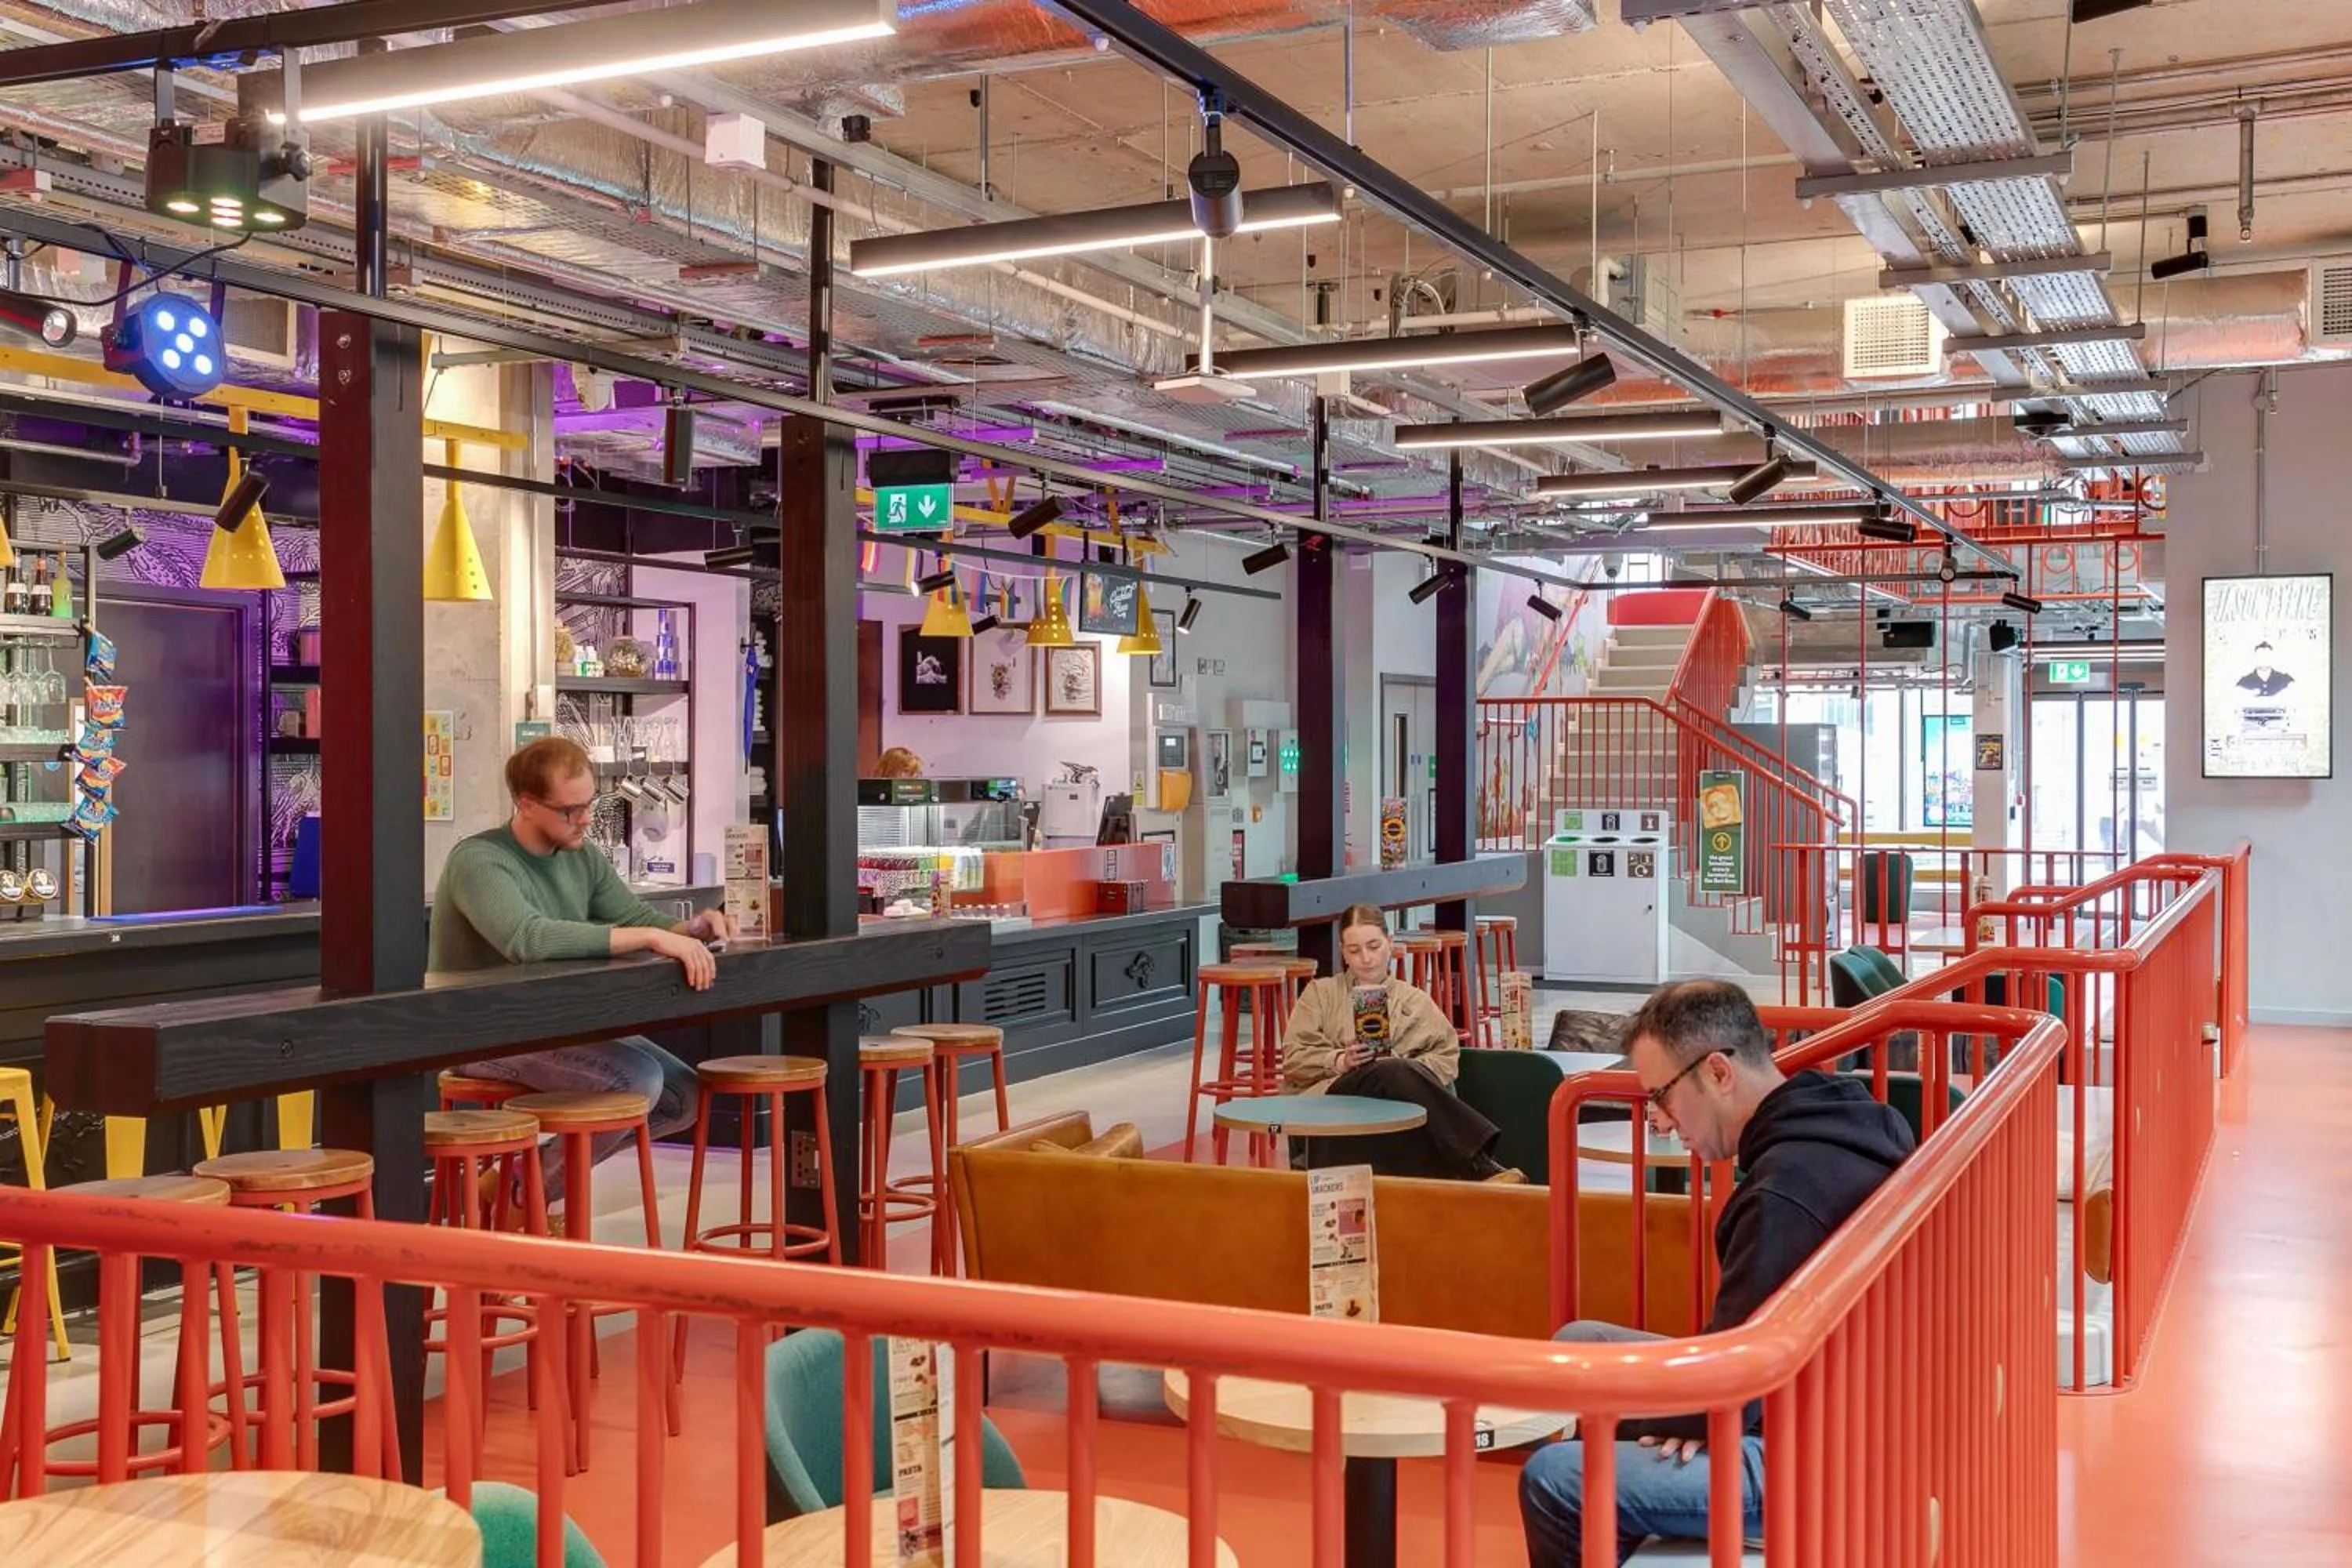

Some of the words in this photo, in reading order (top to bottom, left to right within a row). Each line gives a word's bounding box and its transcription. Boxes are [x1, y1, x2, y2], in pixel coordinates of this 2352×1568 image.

[1314, 1302, 1333, 1312] PASTA
[1475, 1432, 1490, 1449] 18
[898, 1464, 923, 1477] PASTA
